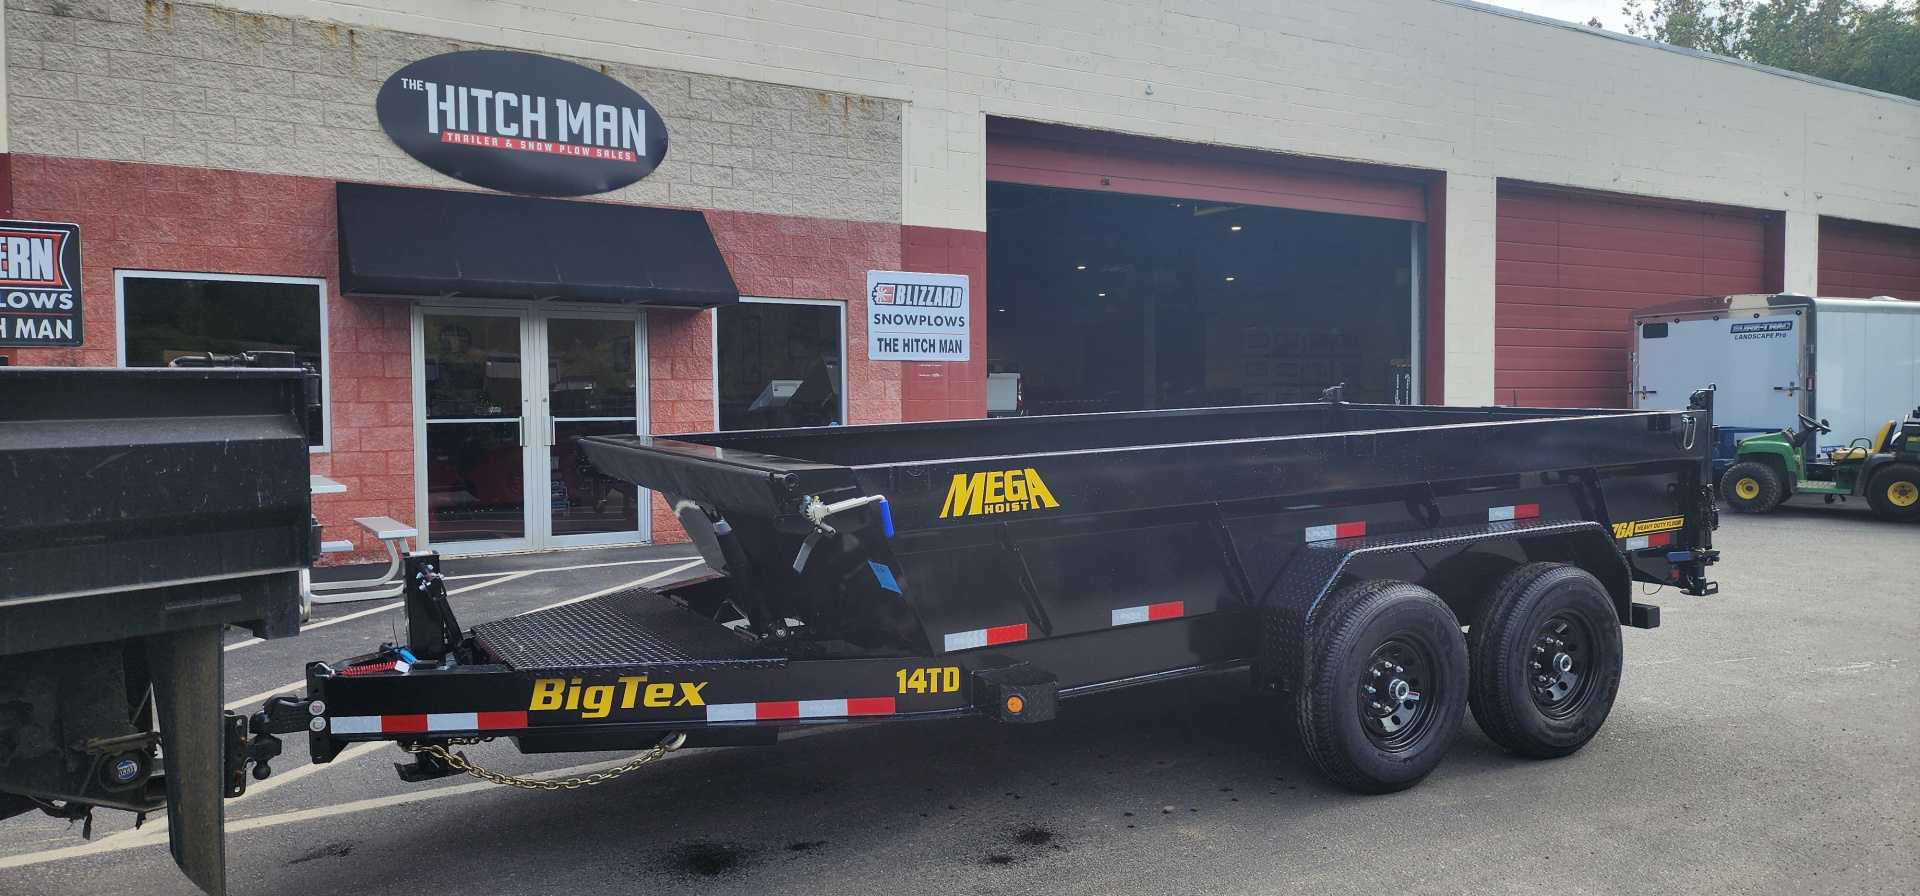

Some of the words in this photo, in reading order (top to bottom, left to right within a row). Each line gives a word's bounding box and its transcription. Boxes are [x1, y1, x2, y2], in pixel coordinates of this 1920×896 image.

[401, 78, 424, 91] THE
[425, 82, 546, 140] HITCH
[556, 98, 646, 156] MAN
[447, 132, 498, 147] TRAILER
[505, 139, 513, 148] &
[520, 140, 553, 152] SNOW
[559, 145, 590, 156] PLOW
[596, 149, 631, 160] SALES
[895, 284, 962, 308] BLIZZARD
[15, 318, 73, 340] MAN
[874, 313, 965, 328] SNOWPLOWS
[877, 337, 899, 353] THE
[903, 338, 936, 354] HITCH
[939, 339, 962, 354] MAN
[1734, 332, 1775, 340] LANDSCAPE
[939, 468, 1060, 518] MEGA
[984, 501, 1029, 514] HOIST
[1636, 523, 1653, 531] HEAVY
[1653, 521, 1667, 529] DUTY
[1666, 519, 1682, 527] FLOOR
[896, 667, 960, 694] 14TD
[529, 675, 708, 719] BigTex
